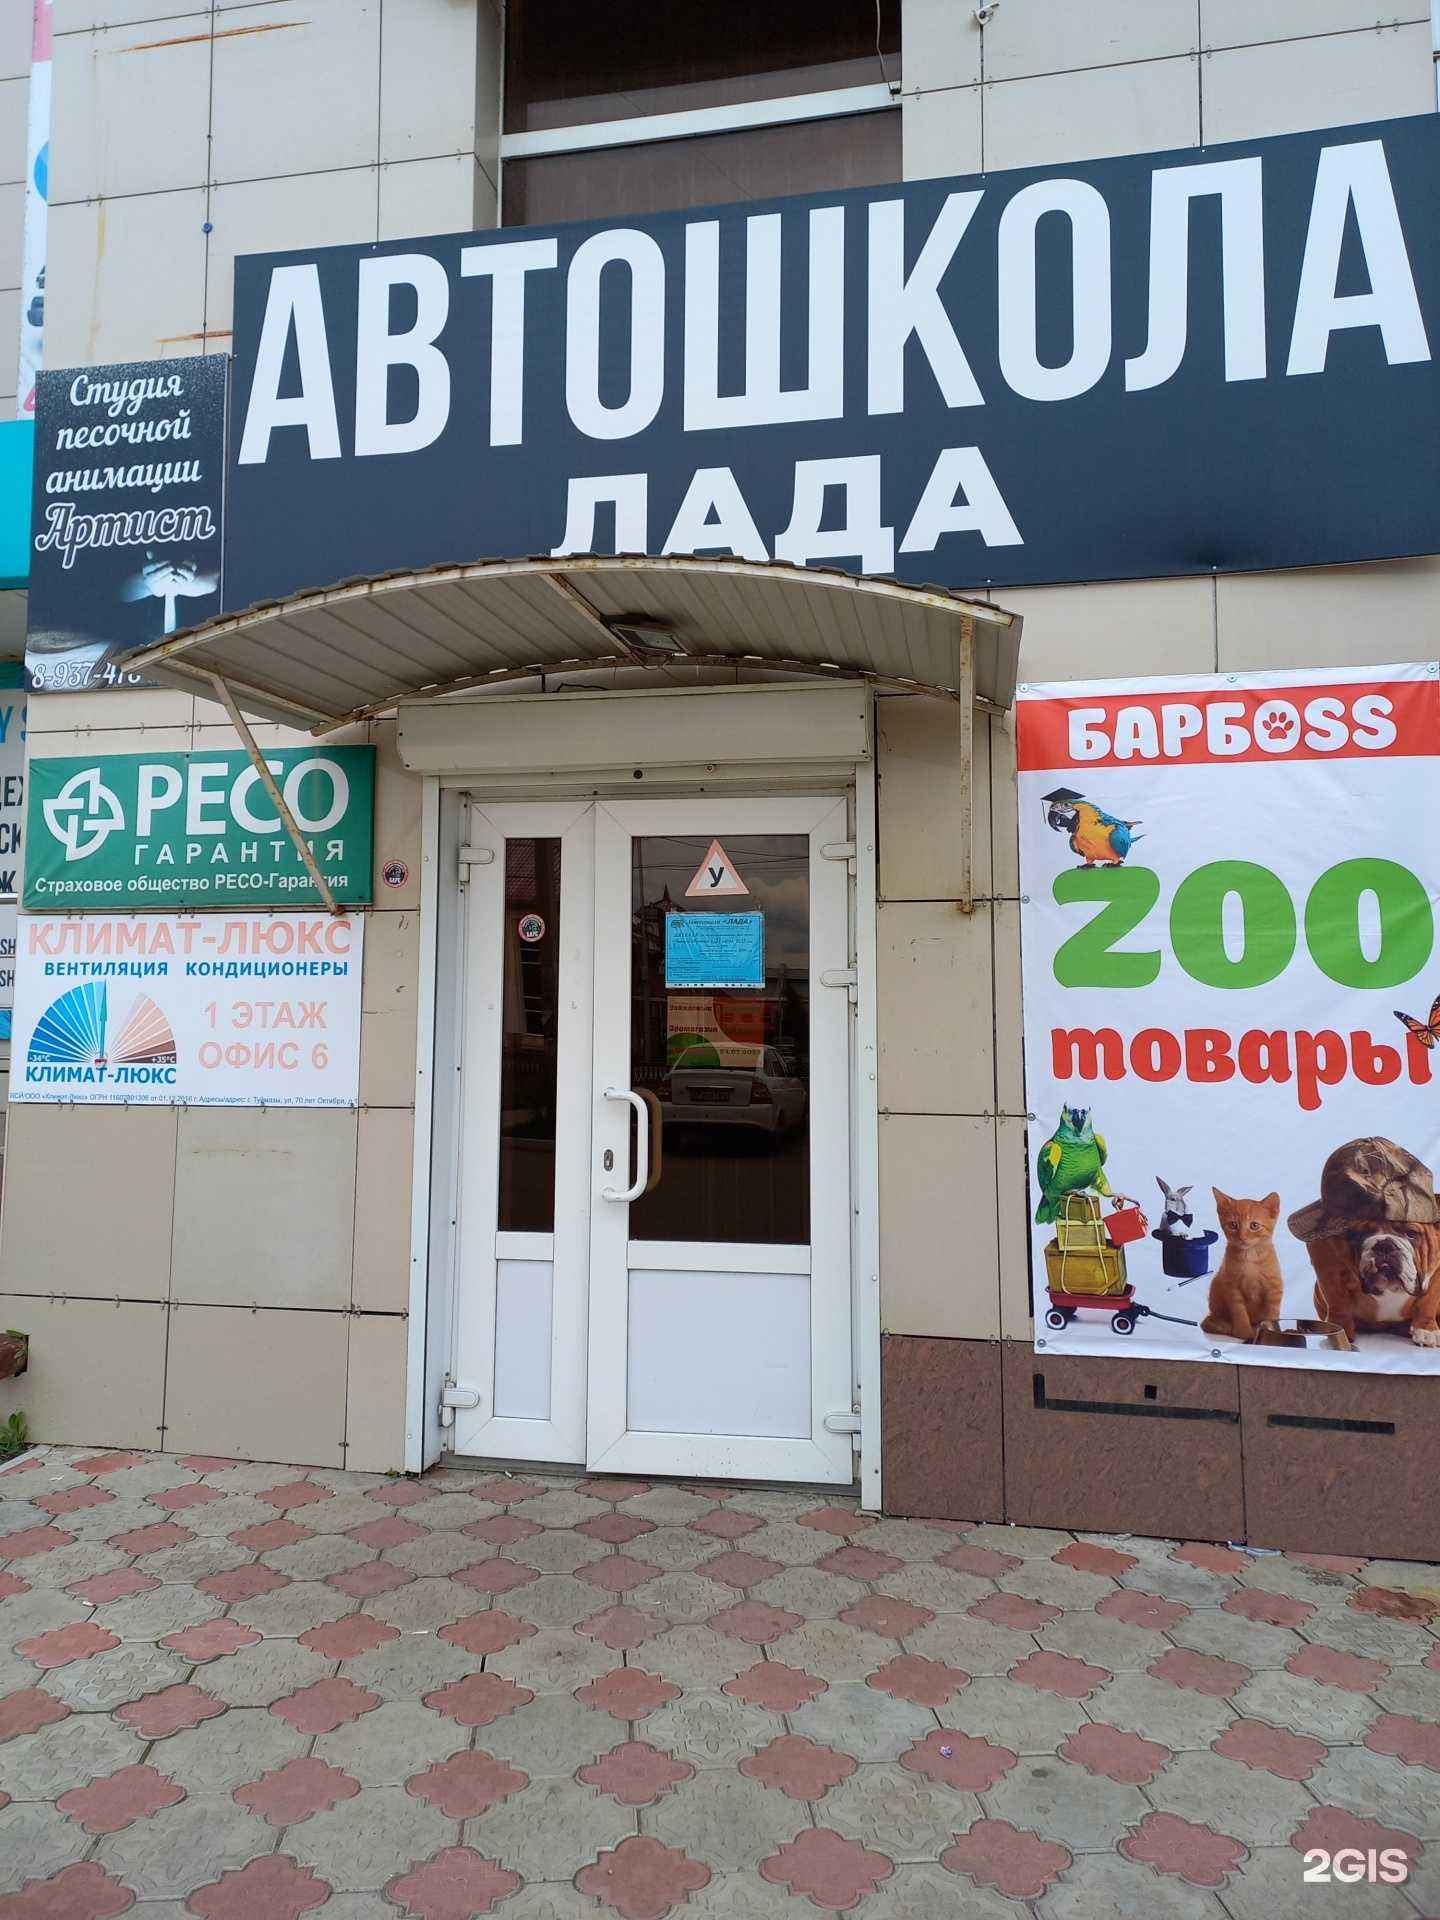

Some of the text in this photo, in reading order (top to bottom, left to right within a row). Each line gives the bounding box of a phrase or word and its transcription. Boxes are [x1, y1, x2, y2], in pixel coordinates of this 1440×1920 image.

[237, 139, 1432, 464] АВТОШКОЛА
[69, 374, 184, 417] Студия
[56, 409, 192, 450] песочной
[46, 460, 202, 493] анимации
[551, 446, 1024, 575] ЛАДА
[35, 502, 216, 569] Артист
[136, 758, 350, 837] РЕСО
[35, 872, 348, 895] Страховое общество РЕСО-Гарания
[708, 866, 724, 888] У
[28, 920, 351, 955] КЛИМАТ-ЛЮКС
[44, 961, 348, 978] ВЕНТИЛЯЦИЯ КОНДИЦИОНЕРЫ
[204, 1001, 328, 1030] 1 ЭТАЖ
[199, 1041, 328, 1070] ОФИС 6
[1051, 1028, 1433, 1111] товары
[26, 1066, 177, 1084] КЛИМАТ-ЛЮКС
